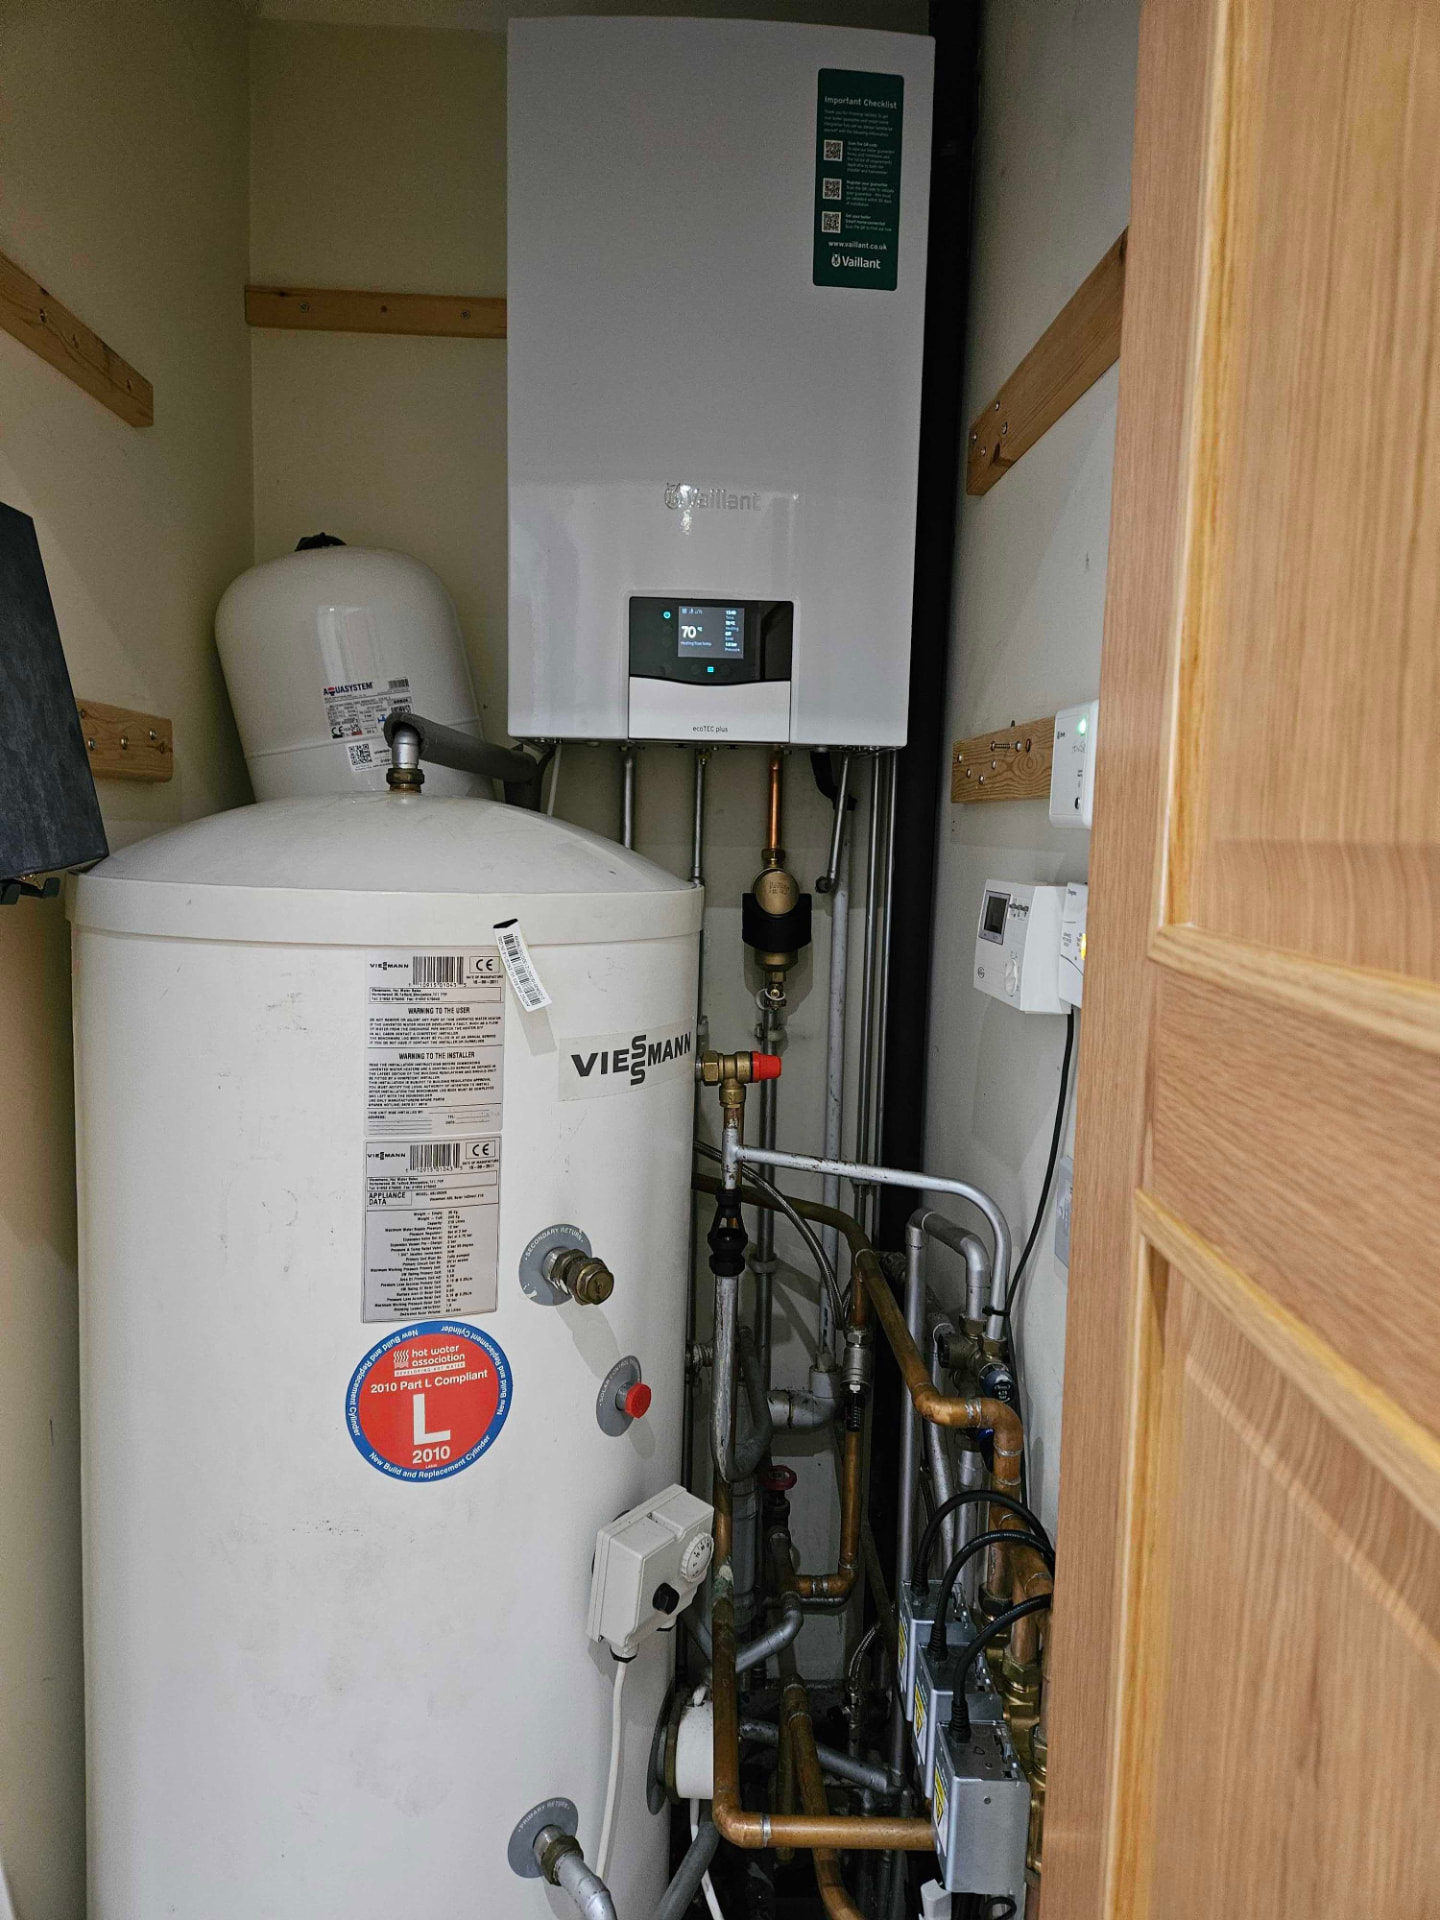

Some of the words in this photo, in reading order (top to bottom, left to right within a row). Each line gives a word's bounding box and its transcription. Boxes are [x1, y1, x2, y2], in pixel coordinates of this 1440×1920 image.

[824, 96, 862, 105] Important
[863, 98, 897, 109] Checklist
[828, 241, 887, 250] www.vaillant.co.uk
[842, 256, 881, 269] Vaillant
[681, 625, 697, 638] 70
[323, 682, 373, 696] AQUASYSTEM
[715, 725, 728, 733] plus
[456, 1006, 470, 1014] USER
[398, 1052, 425, 1060] WARNING
[425, 1052, 434, 1060] TO
[446, 1051, 475, 1059] INSTALLER
[570, 1031, 691, 1086] VIESSMANN
[368, 1198, 387, 1206] DATA
[525, 1228, 559, 1257] SECONDARY
[560, 1227, 583, 1240] RETURN
[401, 1329, 419, 1339] New
[441, 1325, 471, 1338] Cylinder
[382, 1336, 401, 1351] Build
[470, 1332, 502, 1366] Replacement
[369, 1347, 382, 1361] and
[411, 1348, 428, 1357] hot
[430, 1345, 459, 1356] water
[411, 1353, 465, 1367] association
[496, 1365, 506, 1379] and
[350, 1360, 373, 1405] Replacement
[370, 1382, 397, 1393] 2010
[400, 1380, 422, 1390] Part
[424, 1378, 432, 1387] L
[434, 1369, 488, 1386] Compliant
[496, 1400, 506, 1415] New
[348, 1406, 360, 1436] Cylinder
[412, 1393, 451, 1446] L
[368, 1451, 383, 1466] New
[383, 1462, 402, 1475] Build
[418, 1458, 466, 1479] Replacement
[465, 1435, 491, 1461] Cylinder
[412, 1445, 450, 1464] 2010
